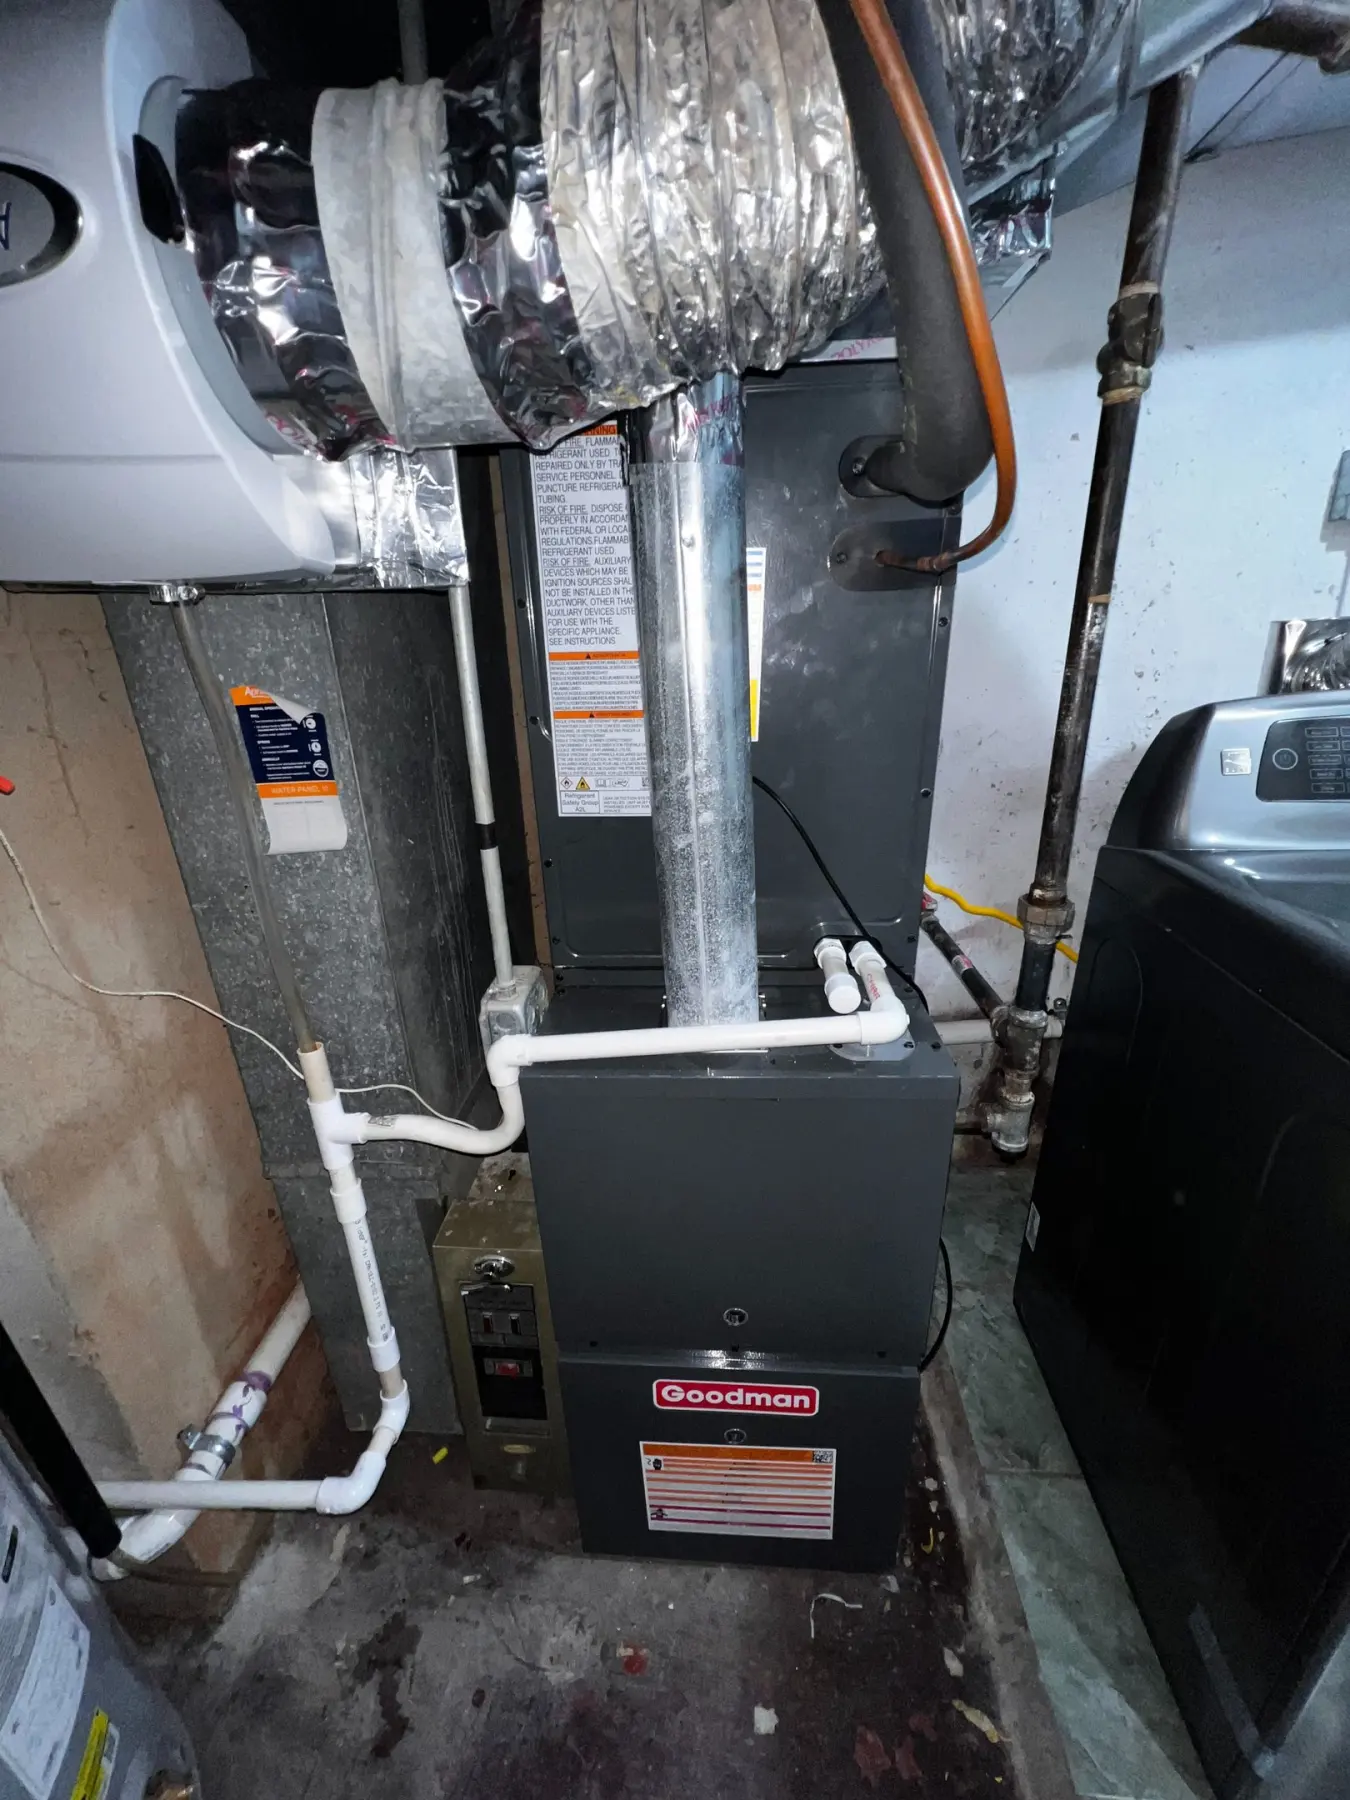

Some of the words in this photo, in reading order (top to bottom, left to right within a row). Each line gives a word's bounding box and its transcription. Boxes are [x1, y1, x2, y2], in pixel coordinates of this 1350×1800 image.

[585, 437, 620, 447] FLAMMA
[536, 460, 572, 471] REPAIRED
[574, 460, 594, 470] ONLY
[597, 459, 608, 469] BY
[536, 471, 569, 483] SERVICE
[537, 482, 578, 493] PUNCTURE
[540, 505, 556, 514] RISK
[558, 505, 568, 514] OF
[591, 503, 623, 513] DISPOSE
[540, 515, 579, 525] PROPERLY
[580, 515, 588, 524] IN
[540, 526, 559, 536] WITH
[561, 525, 593, 535] FEDERAL
[595, 524, 607, 534] OR
[542, 547, 593, 557] REFRIGERANT
[542, 558, 558, 567] RISK
[560, 557, 570, 566] OF
[594, 555, 632, 566] AUXILIARY
[543, 568, 575, 577] DEVICES
[576, 567, 600, 576] WHICH
[601, 566, 617, 576] MAY
[618, 566, 629, 575] BE
[545, 578, 576, 588] IGNITION
[577, 577, 612, 587] SOURCES
[545, 588, 560, 598] NOT
[561, 588, 571, 597] BE
[573, 587, 612, 597] INSTALLED
[612, 587, 620, 596] IN
[590, 597, 616, 607] OTHER
[546, 608, 583, 617] AUXILIARY
[584, 607, 615, 617] DEVICES
[547, 618, 564, 627] FOR
[564, 618, 579, 627] USE
[580, 617, 598, 626] WITH
[599, 616, 614, 626] THE
[548, 627, 581, 637] SPECIFIC
[549, 637, 563, 646] SEE
[564, 793, 596, 801] Refrigerant
[562, 799, 580, 807] Safety
[581, 799, 600, 807] Group
[661, 1385, 810, 1409] Goodman
